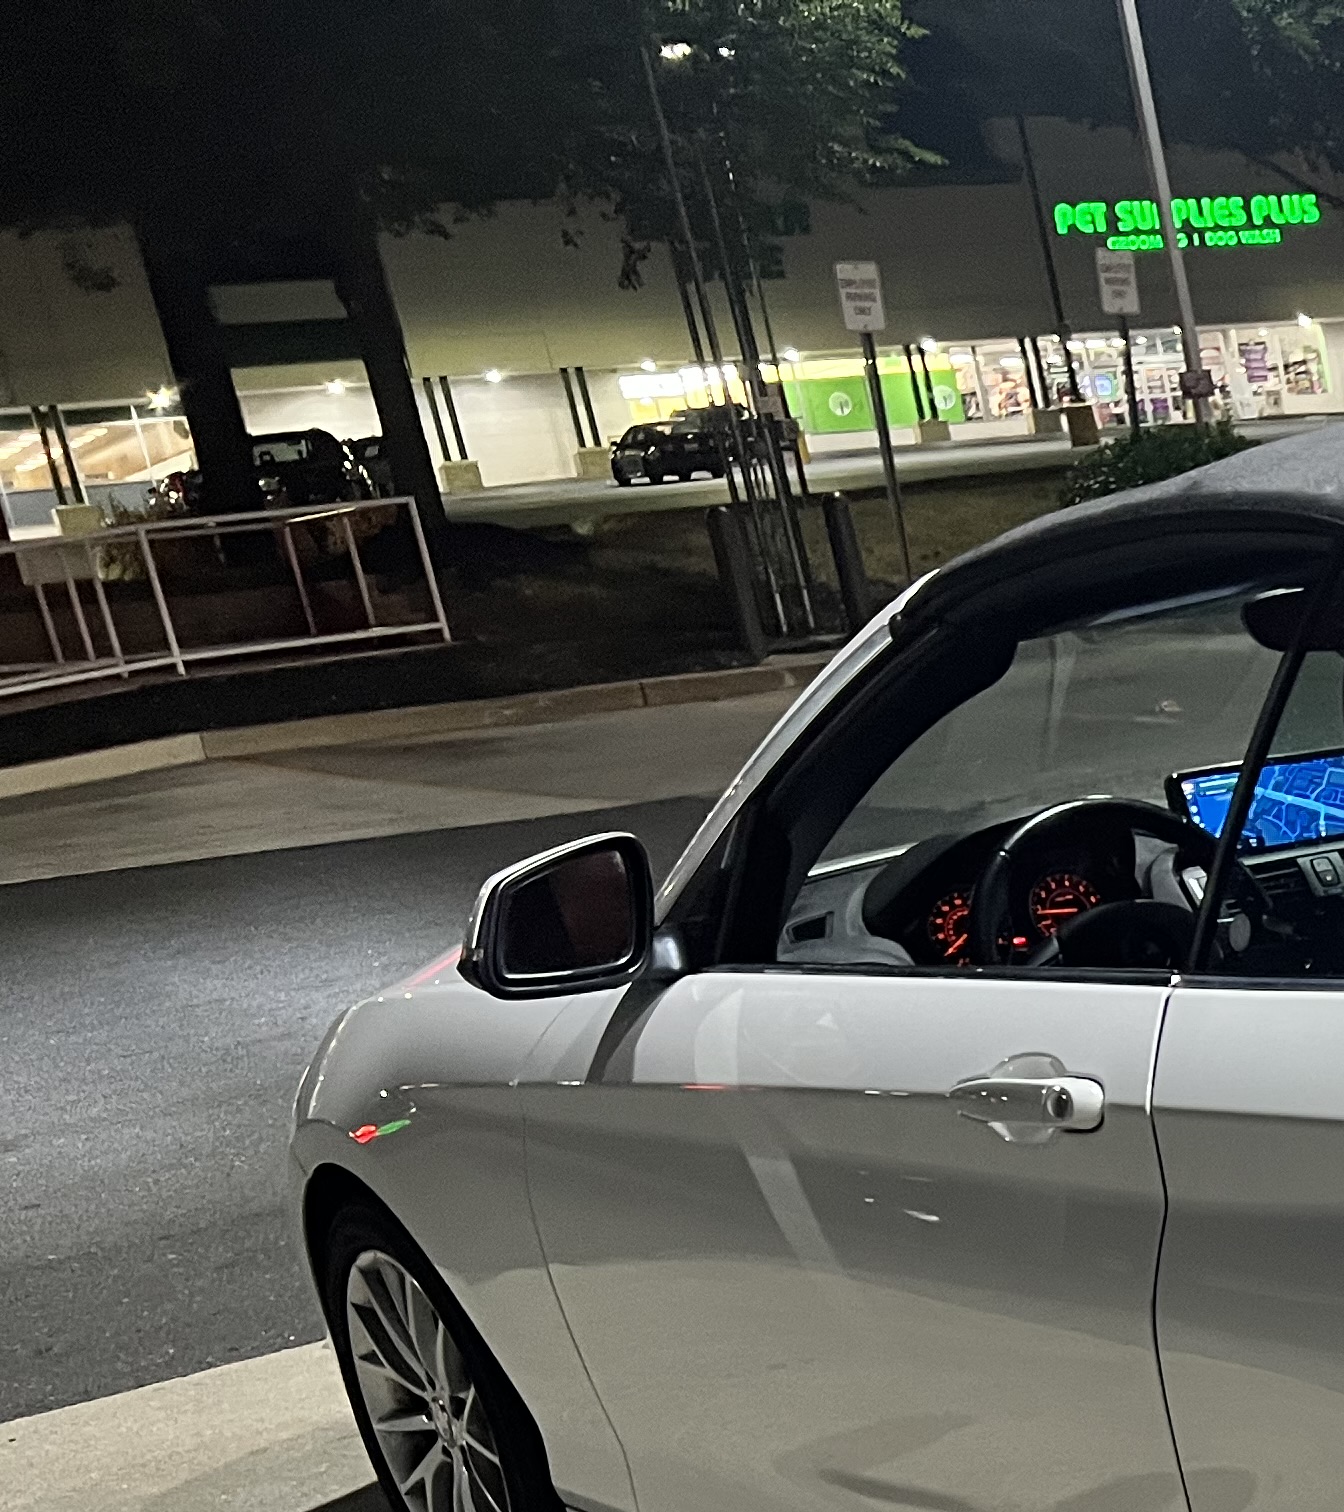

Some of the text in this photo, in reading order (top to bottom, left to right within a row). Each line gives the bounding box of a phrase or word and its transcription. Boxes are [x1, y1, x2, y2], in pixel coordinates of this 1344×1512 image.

[1054, 194, 1320, 234] PET SUPLIES PLUS
